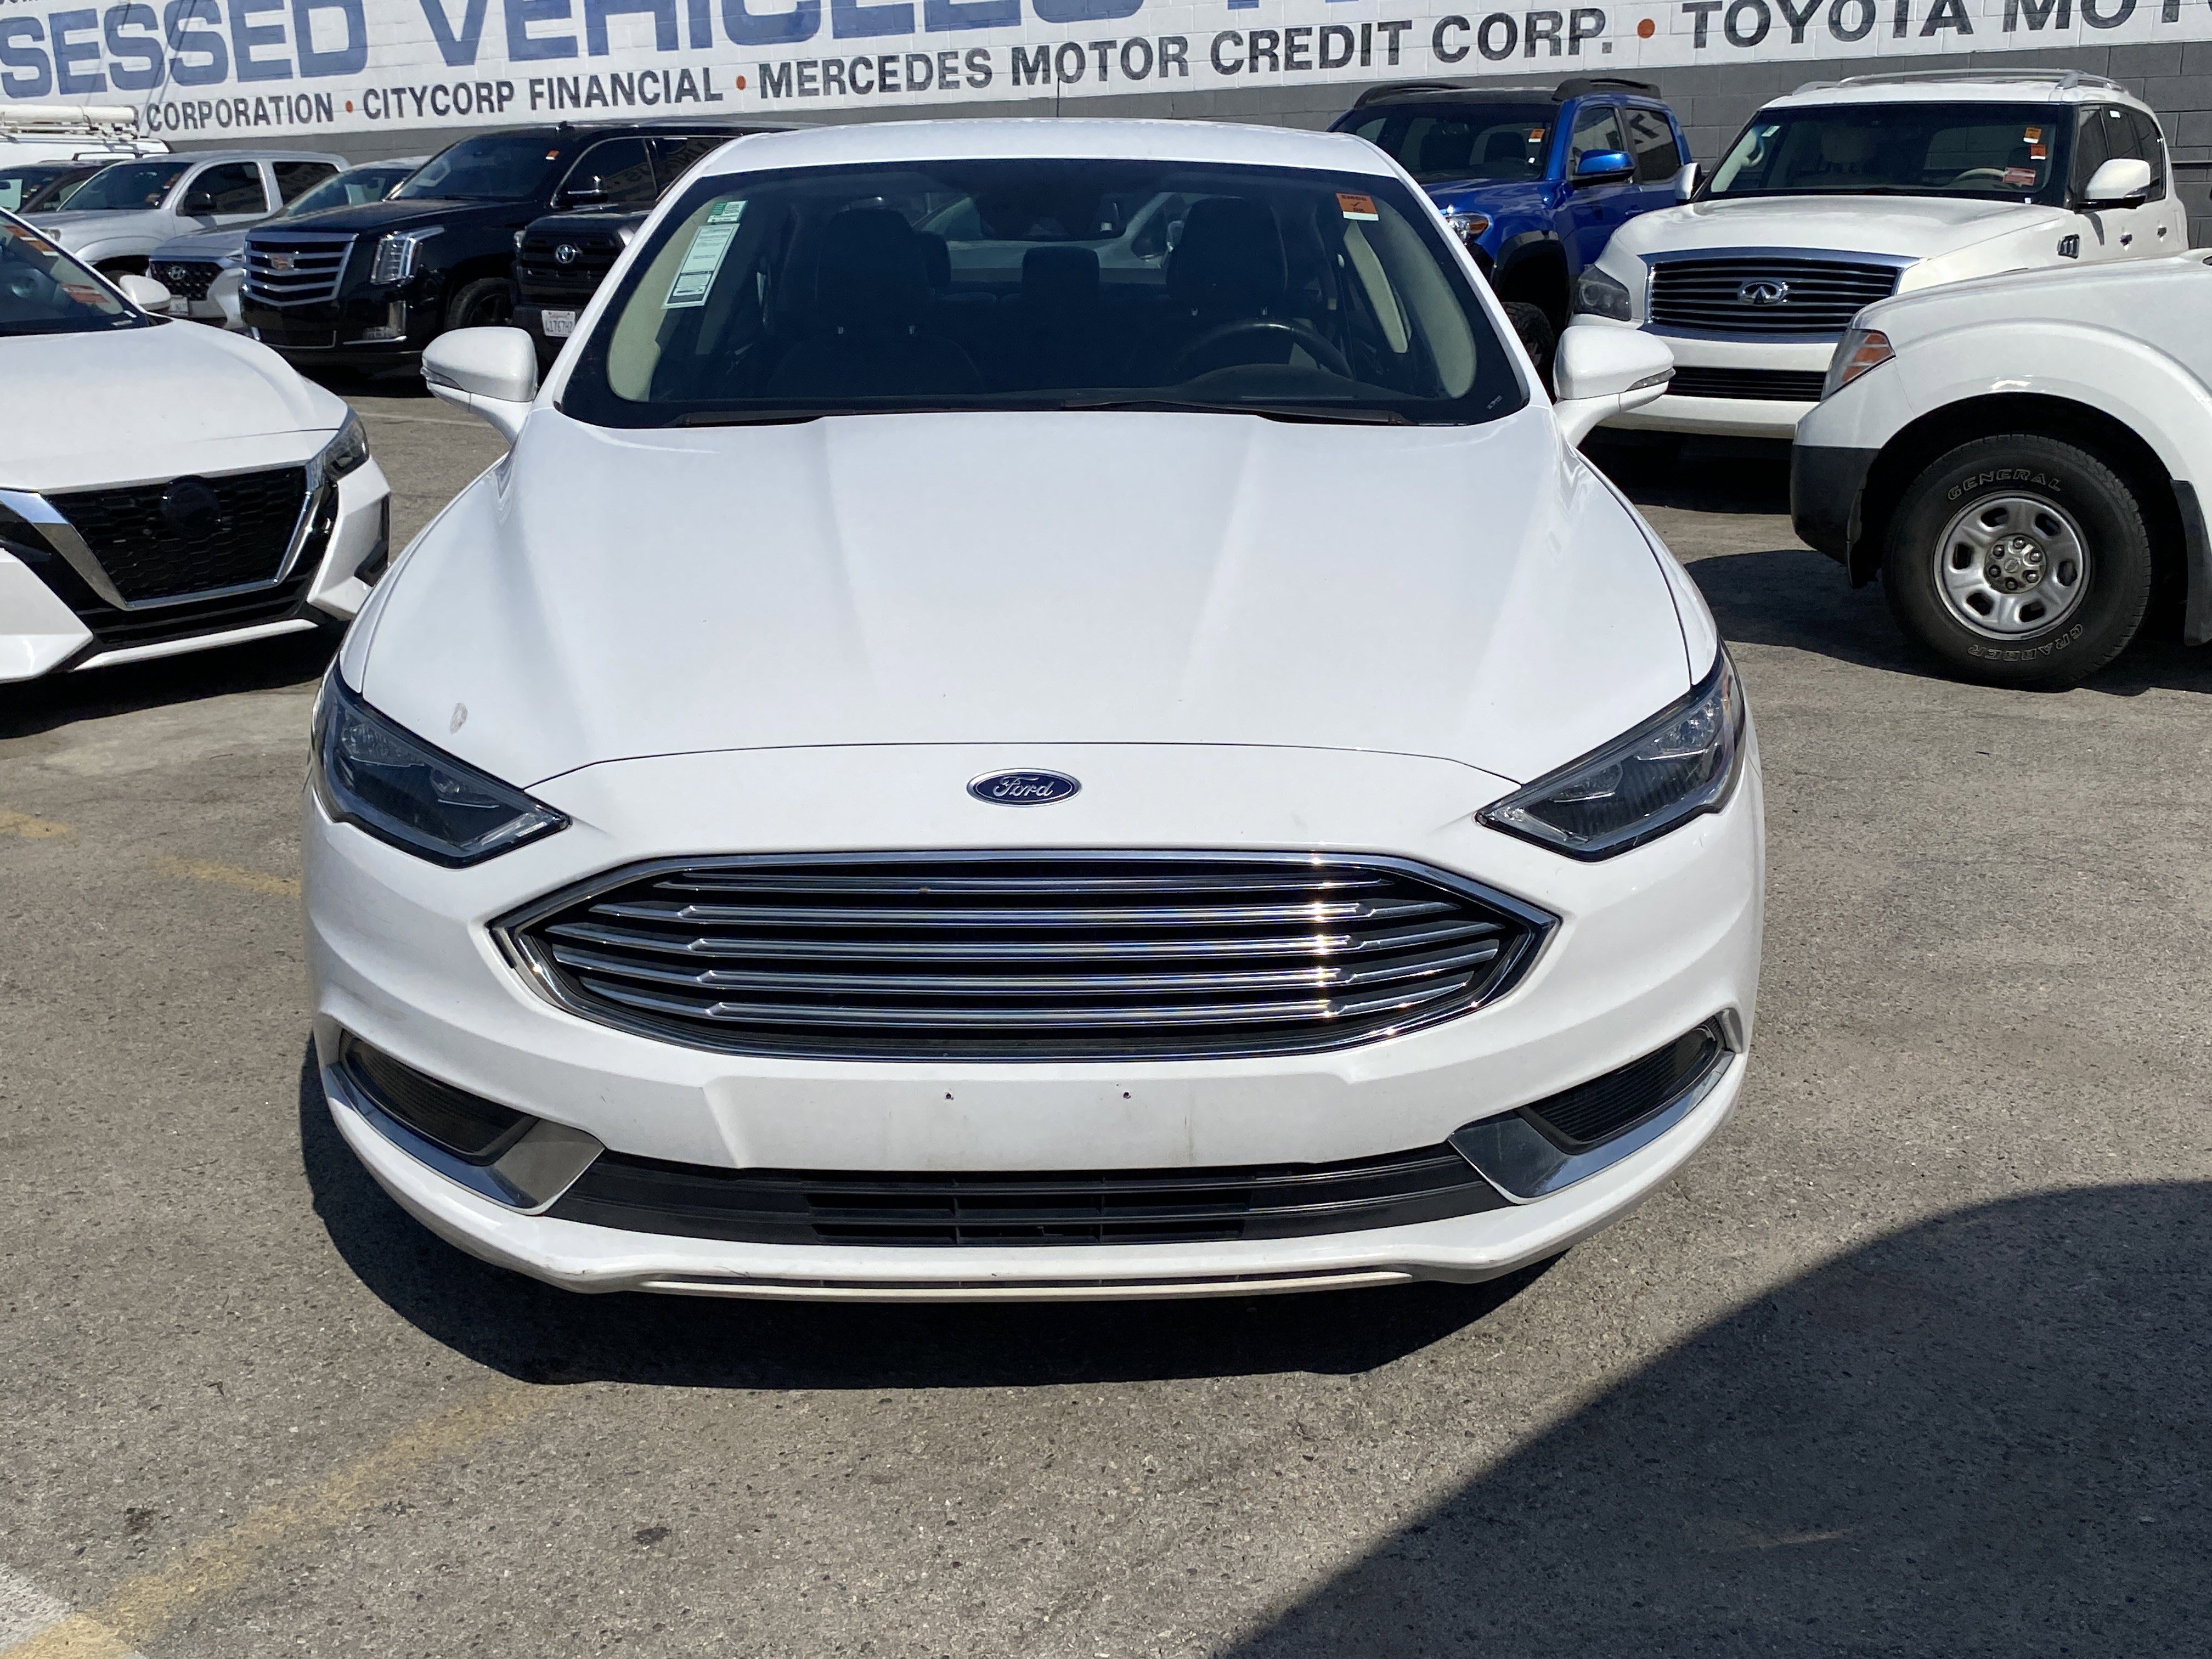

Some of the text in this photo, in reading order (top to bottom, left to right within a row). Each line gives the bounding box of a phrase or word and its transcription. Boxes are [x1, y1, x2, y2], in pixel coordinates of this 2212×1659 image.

[0, 0, 1145, 99] SESSED VEHI
[147, 92, 334, 131] CORPORATION
[363, 81, 514, 120] CITYCORP
[529, 67, 723, 110] FINANCIAL
[759, 47, 992, 99] MERCEDES
[1011, 36, 1189, 86] MOTOR
[1210, 20, 1412, 76] CREDIT
[1432, 8, 1612, 64] CORP.
[1681, 0, 1974, 48] TOYOTA
[2001, 0, 2212, 32] MO
[1948, 469, 2061, 501] GENERAL
[1967, 623, 2083, 662] GRABBER
[993, 776, 1054, 797] Ford
